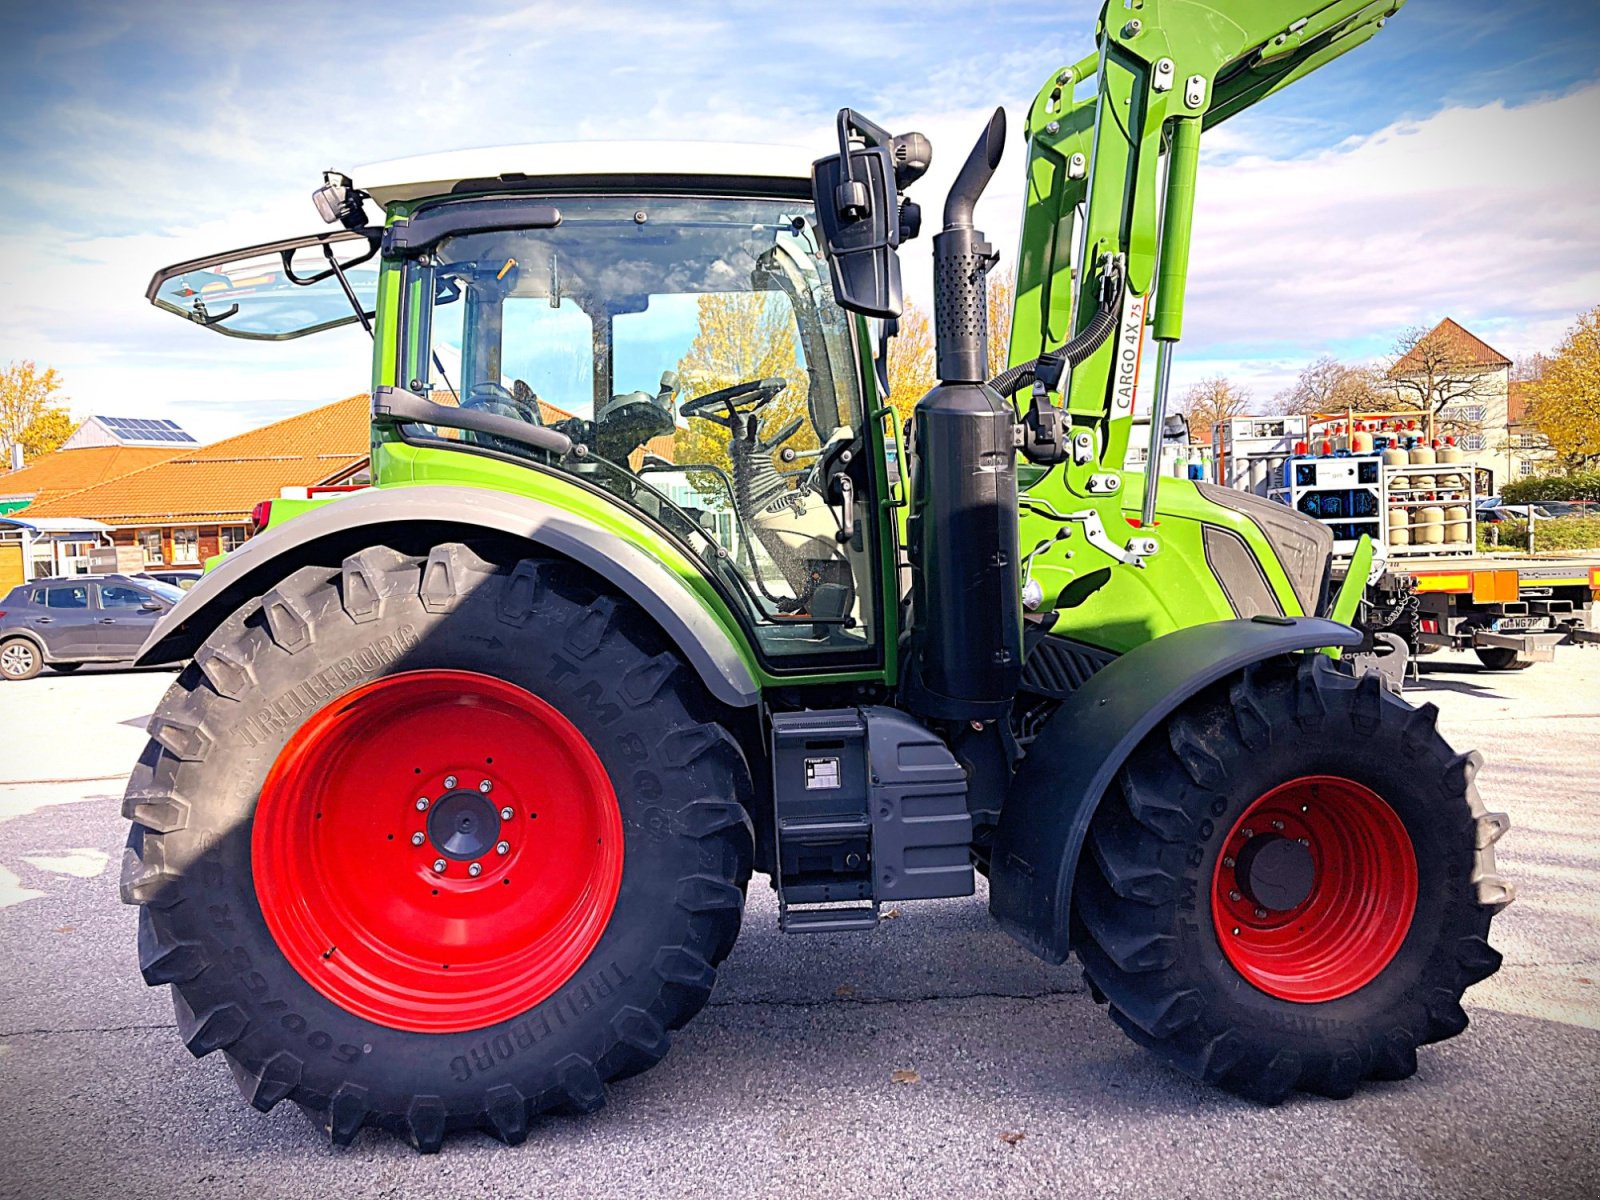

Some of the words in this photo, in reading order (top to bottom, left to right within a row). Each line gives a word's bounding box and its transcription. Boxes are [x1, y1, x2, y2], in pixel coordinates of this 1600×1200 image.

[1131, 304, 1142, 318] 75
[1124, 322, 1139, 345] 4X
[1117, 348, 1135, 409] CARGO
[1515, 618, 1526, 628] WG
[230, 622, 422, 749] TRELLEBORG
[450, 960, 635, 1083] TRELLEBORG
